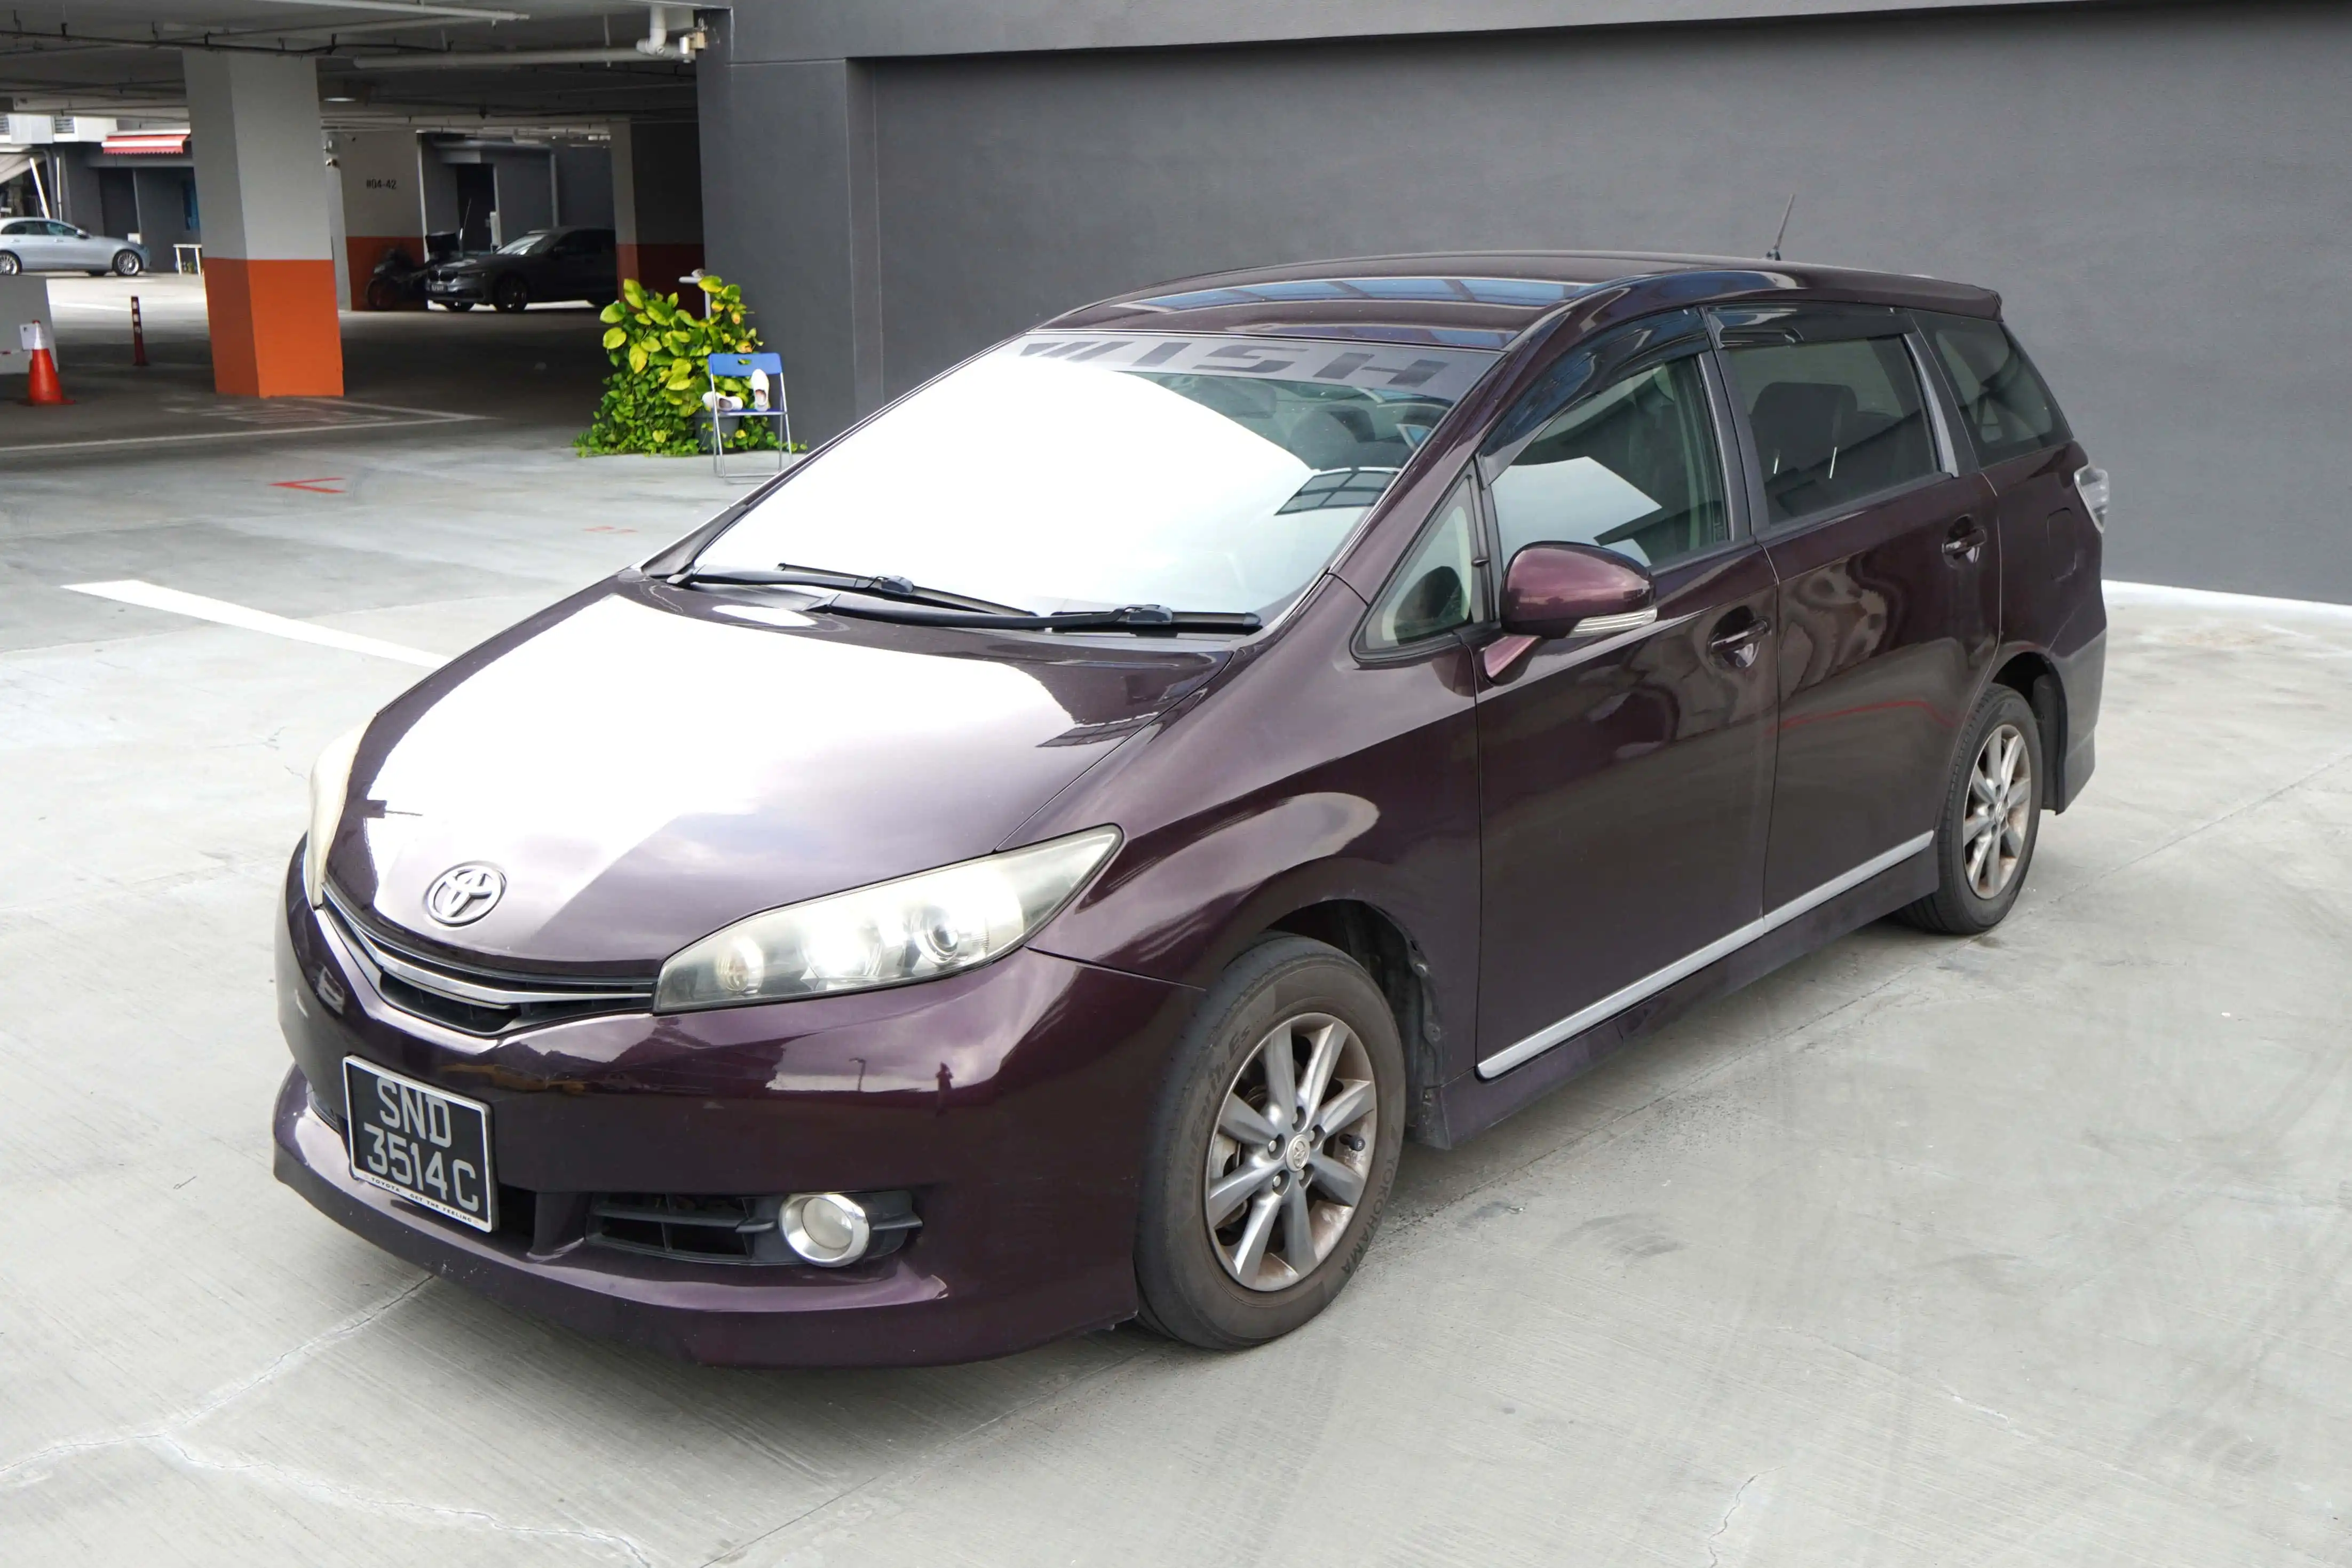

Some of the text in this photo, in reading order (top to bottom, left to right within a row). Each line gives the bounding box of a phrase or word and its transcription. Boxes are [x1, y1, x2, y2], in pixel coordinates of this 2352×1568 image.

[376, 1076, 452, 1148] SND
[363, 1122, 479, 1213] 3514C
[371, 1177, 472, 1223] TOYOTA GET THE FEELING
[1341, 1157, 1397, 1275] YOKOHAMA
